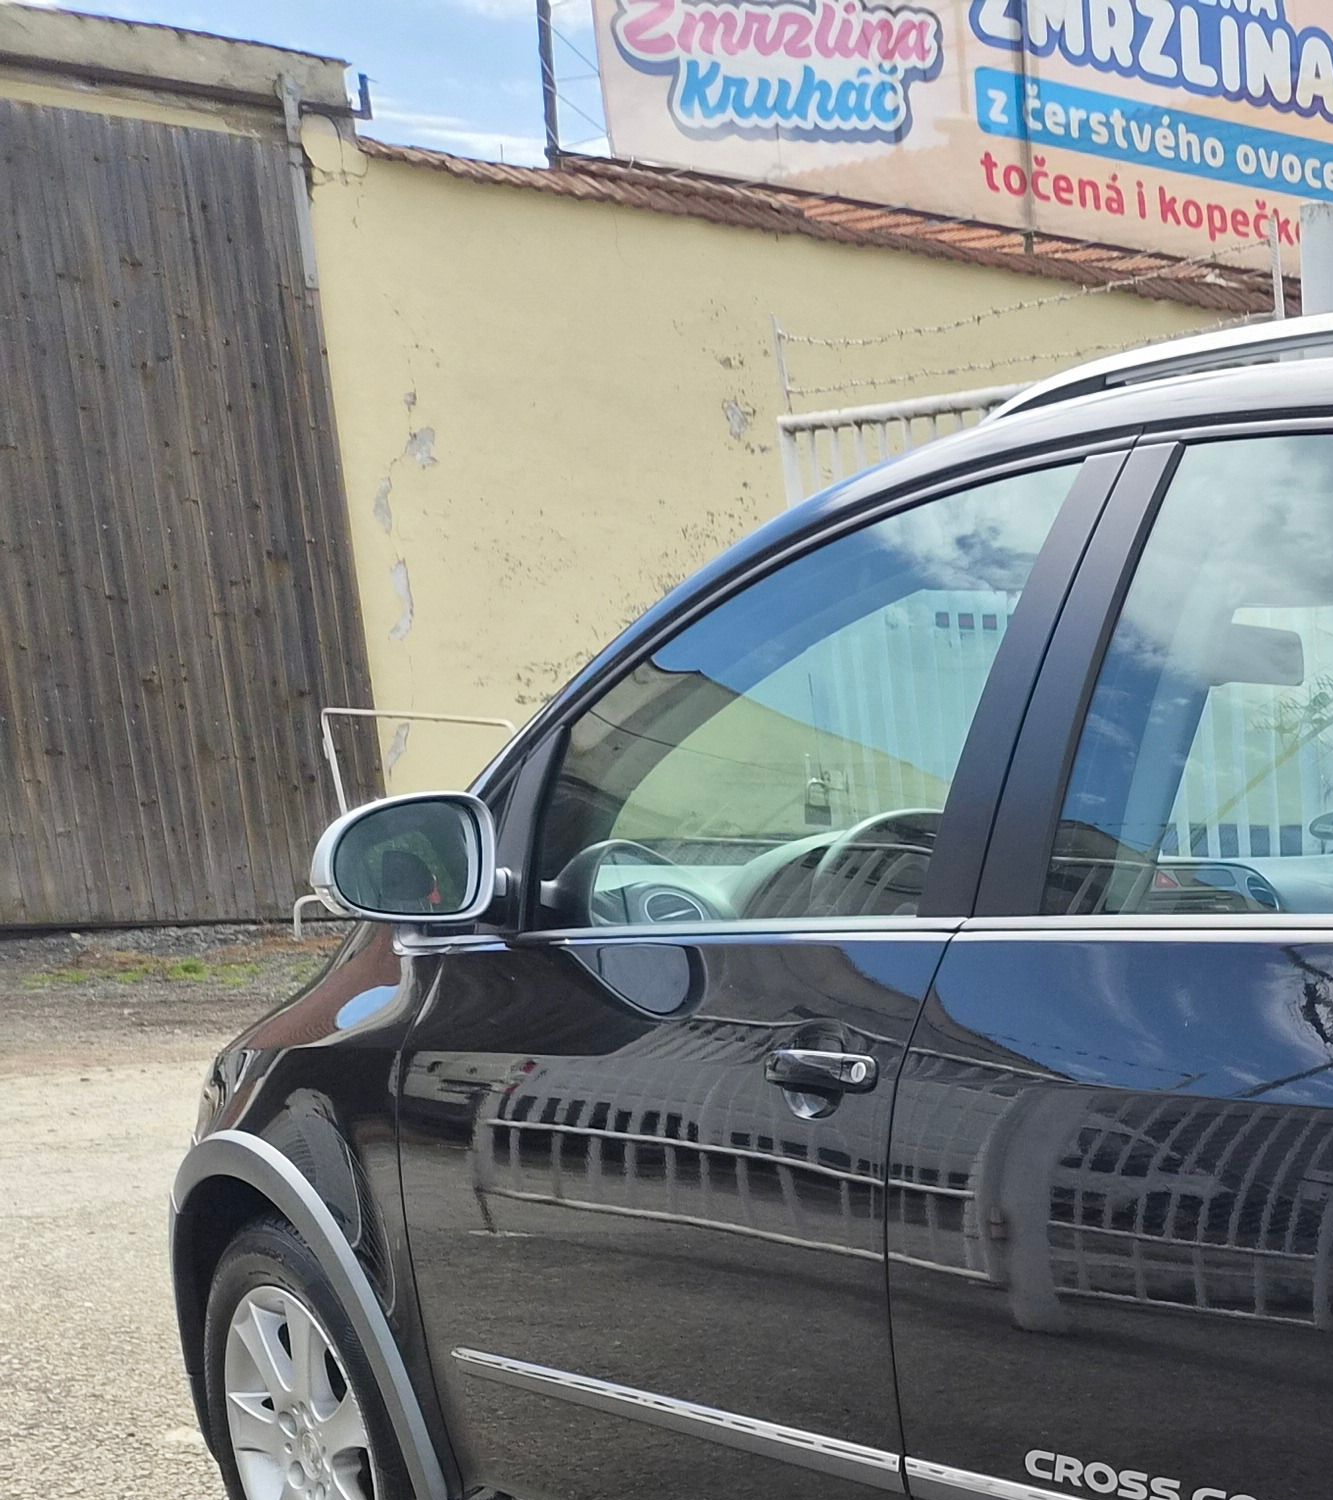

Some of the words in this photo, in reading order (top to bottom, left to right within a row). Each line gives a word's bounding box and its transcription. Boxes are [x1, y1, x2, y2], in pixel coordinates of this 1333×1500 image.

[622, 0, 930, 62] Zmrzlina
[680, 59, 901, 122] Kruháč
[987, 88, 1009, 124] z
[1027, 83, 1226, 168] čerstvého
[980, 151, 1126, 217] točená
[1136, 180, 1147, 219] i
[1158, 185, 1300, 247] kopečk
